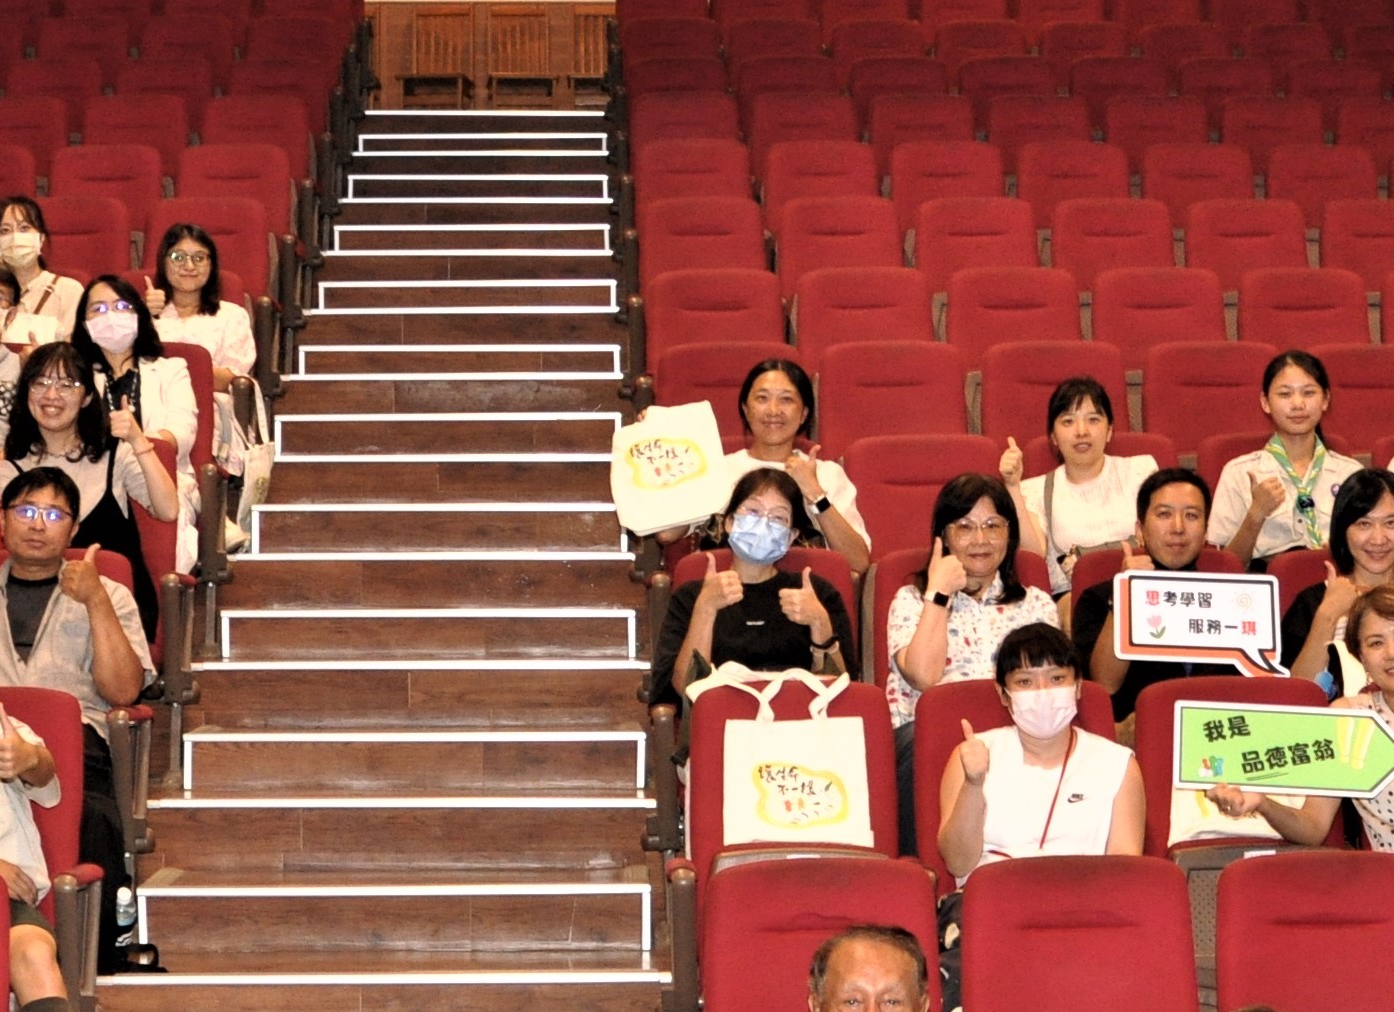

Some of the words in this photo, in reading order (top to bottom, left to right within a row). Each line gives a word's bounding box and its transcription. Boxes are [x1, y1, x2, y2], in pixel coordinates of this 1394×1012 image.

[1145, 589, 1213, 609] 思考學習
[1188, 618, 1257, 636] 服務一琪
[1202, 715, 1251, 743] 我是
[1241, 738, 1336, 775] 品德富翁
